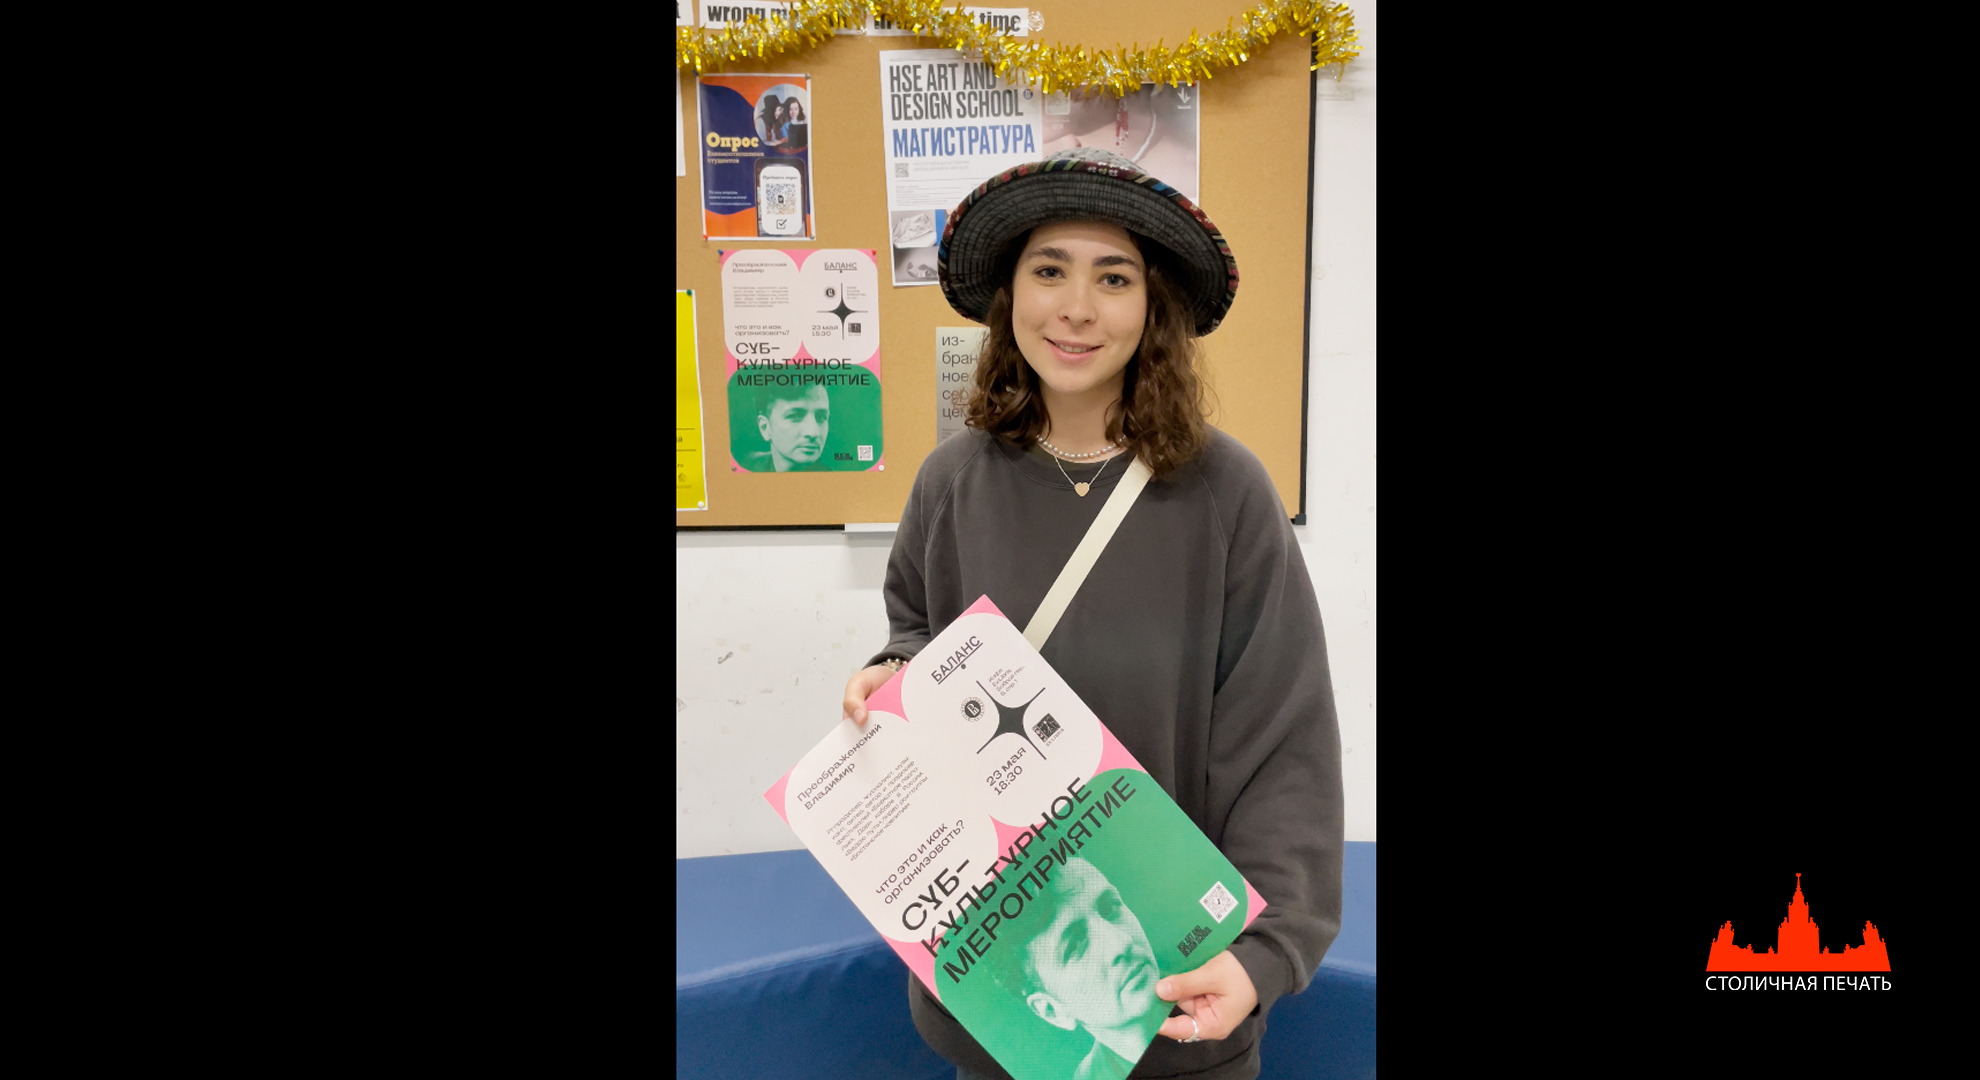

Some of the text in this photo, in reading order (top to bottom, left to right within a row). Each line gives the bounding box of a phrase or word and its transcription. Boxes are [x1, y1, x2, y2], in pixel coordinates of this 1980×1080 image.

[979, 11, 1021, 32] time
[889, 62, 997, 93] HSE ART AND
[891, 89, 1024, 121] DESIGN SCHOOL
[706, 131, 759, 152] Опрос
[893, 124, 1035, 158] МАГИСТРАТУРА
[824, 262, 858, 270] БАЛАНС
[735, 342, 780, 355] СУБ-
[942, 336, 965, 346] из-
[736, 358, 852, 371] КУЛЬТУРНОЕ
[737, 374, 871, 386] МЕРОПРИЯТИЕ
[942, 372, 969, 383] ное
[931, 635, 980, 682] БАЛАНС
[797, 723, 882, 802] Преображенский
[986, 747, 1026, 786] 23 мая
[804, 762, 856, 810] Владимир
[993, 765, 1023, 795] 18:30
[875, 823, 948, 894] что это и как
[884, 819, 965, 905] организовать?
[920, 776, 1094, 959] КУЛЬТУРНОЕ
[899, 857, 973, 932] СУБ-
[942, 775, 1136, 984] МЕРОПРИЯТИЕ
